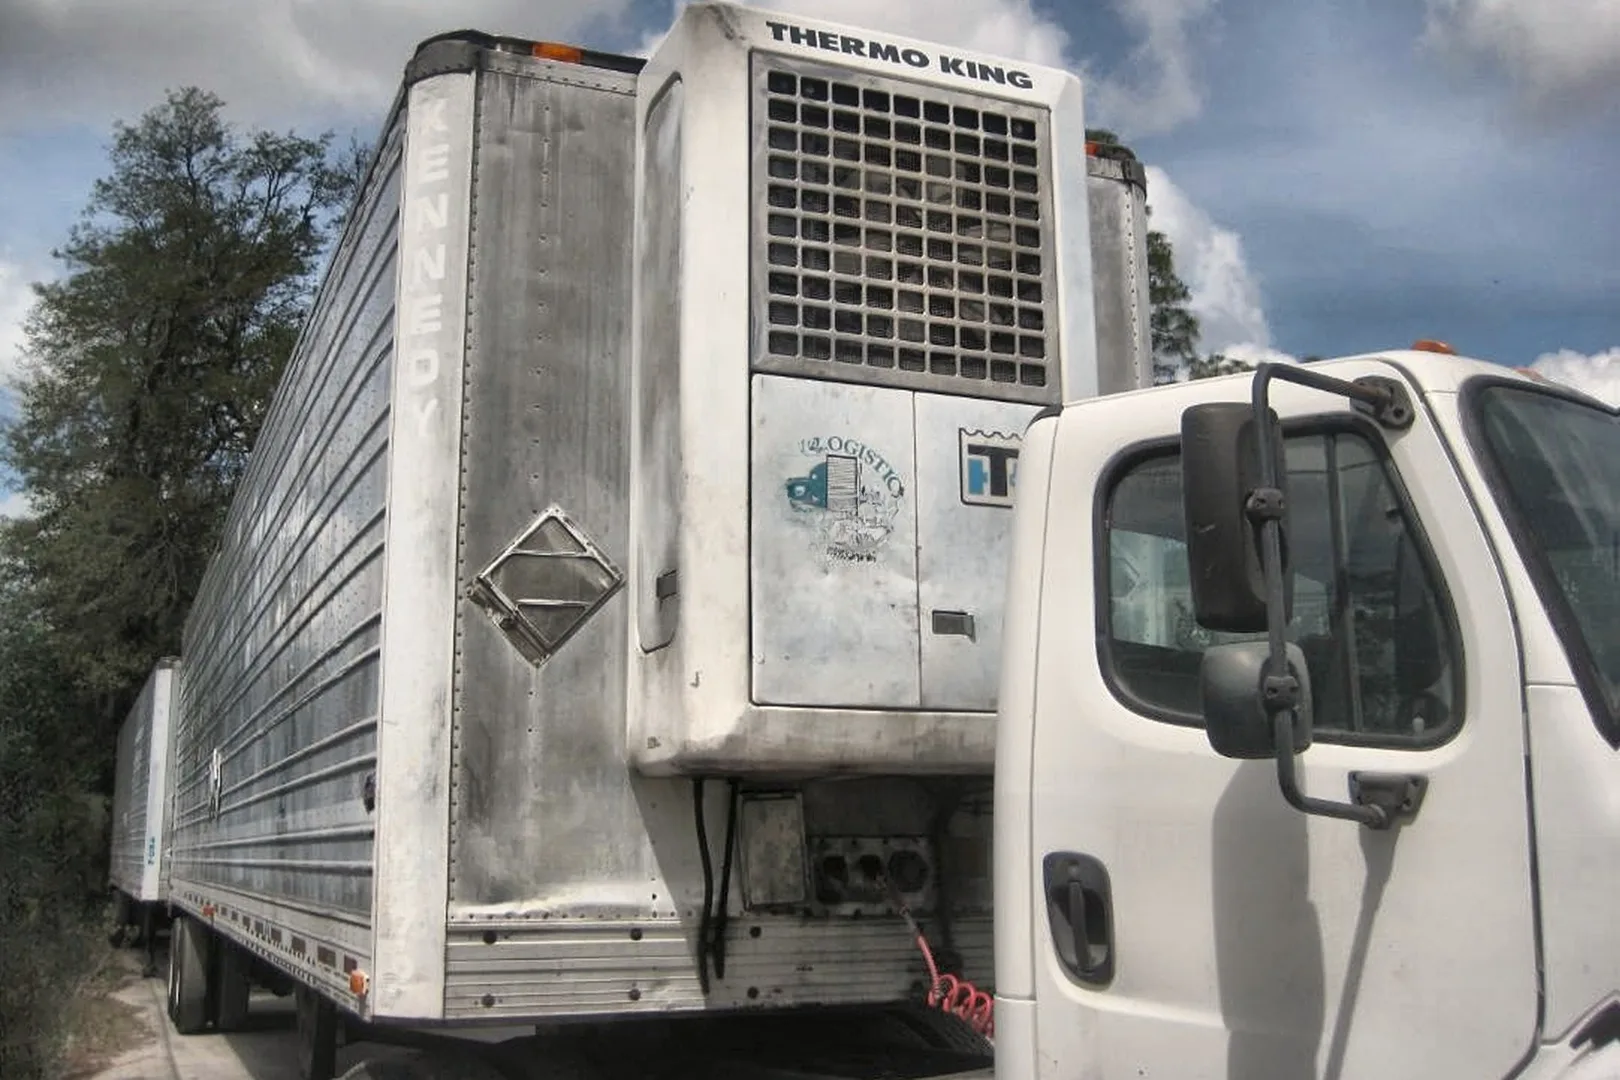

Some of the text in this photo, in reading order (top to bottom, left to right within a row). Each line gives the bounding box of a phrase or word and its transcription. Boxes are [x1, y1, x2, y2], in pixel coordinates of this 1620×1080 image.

[766, 21, 1033, 89] THERMO KING
[411, 98, 449, 437] KENNEDY
